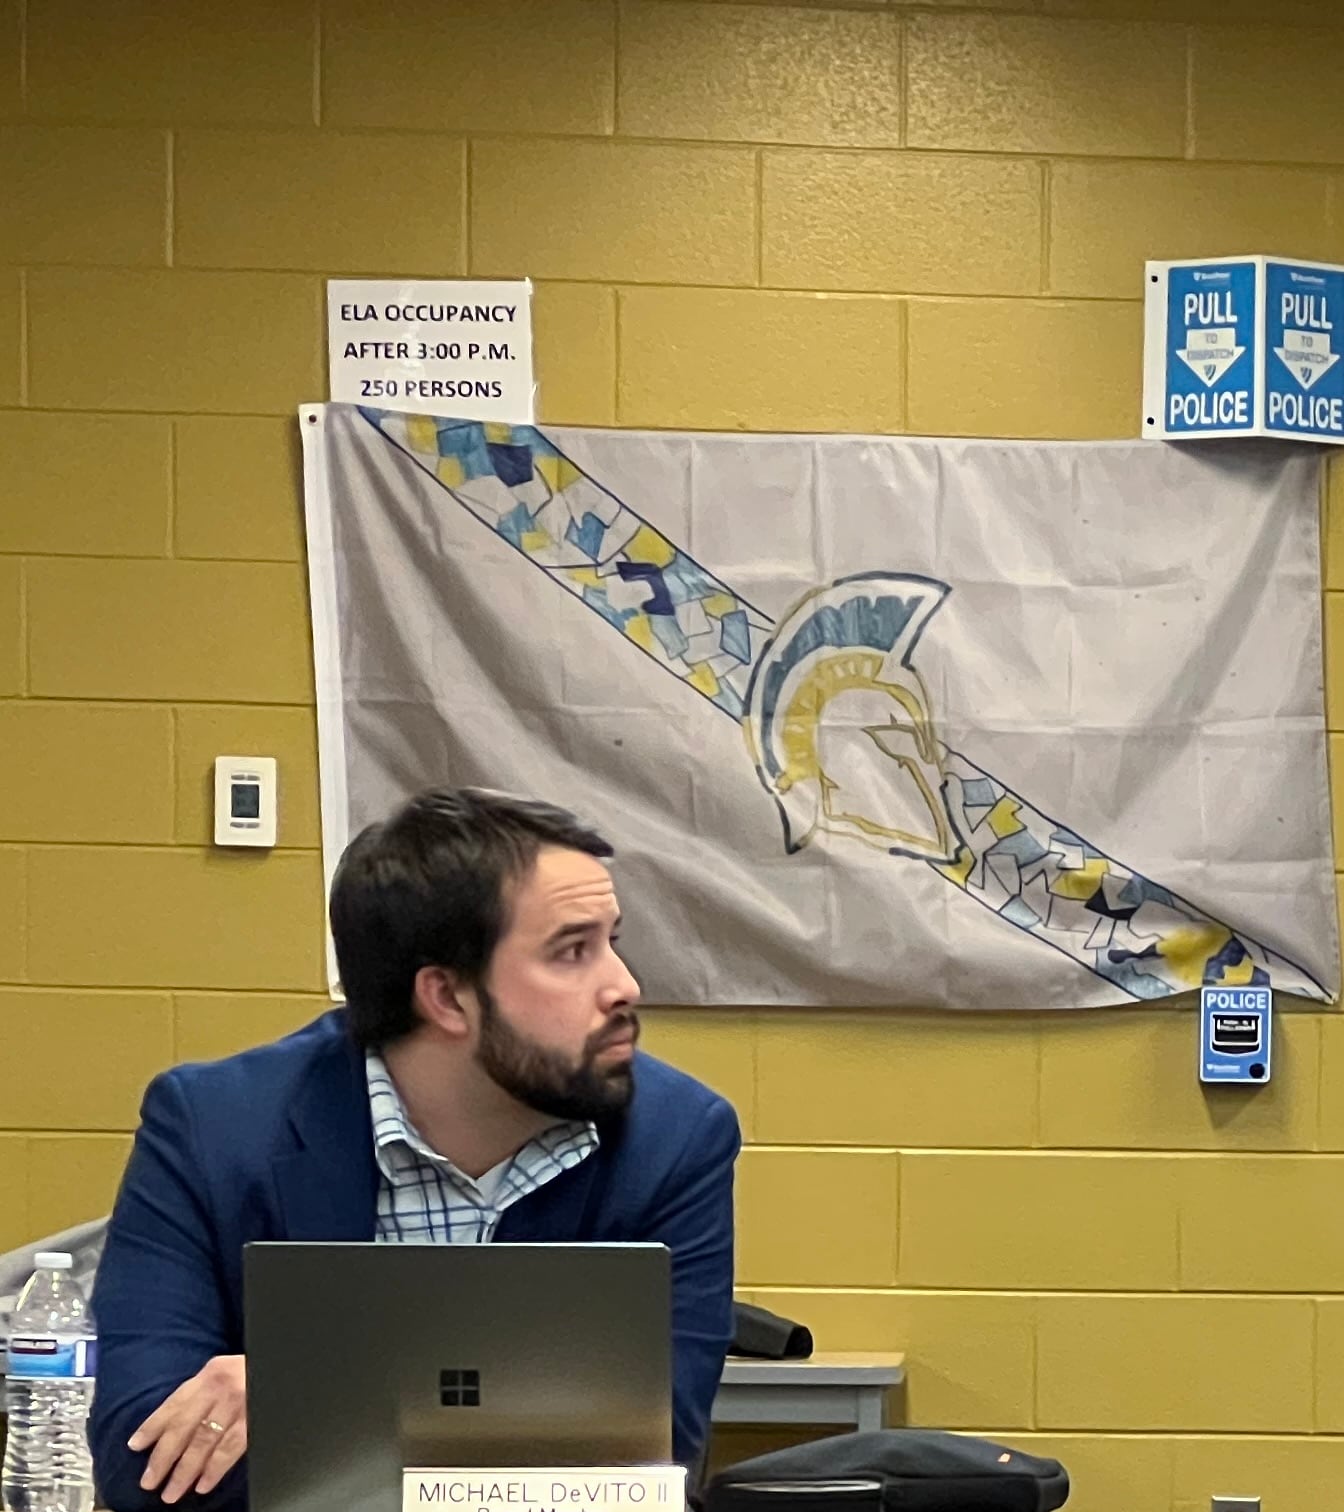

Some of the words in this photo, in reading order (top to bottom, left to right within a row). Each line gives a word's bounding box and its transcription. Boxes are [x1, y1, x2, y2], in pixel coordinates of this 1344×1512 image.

[340, 303, 378, 322] ELA
[384, 303, 517, 323] OCCUPANCY
[1184, 291, 1238, 326] PULL
[1281, 292, 1333, 329] PULL
[1205, 333, 1218, 345] TO
[1301, 335, 1313, 347] TO
[342, 342, 409, 360] AFTER
[416, 343, 461, 360] 3:00
[467, 343, 516, 361] P.M.
[1186, 348, 1235, 361] DISPATCH
[1284, 350, 1329, 364] DISPATCH
[360, 379, 398, 397] 250
[404, 380, 502, 398] PERSONS
[1169, 391, 1248, 426] POLICE
[1269, 391, 1343, 430] POLICE
[1206, 993, 1267, 1009] POLICE
[419, 1482, 538, 1504] MICHAEL
[551, 1482, 646, 1504] DeVITO
